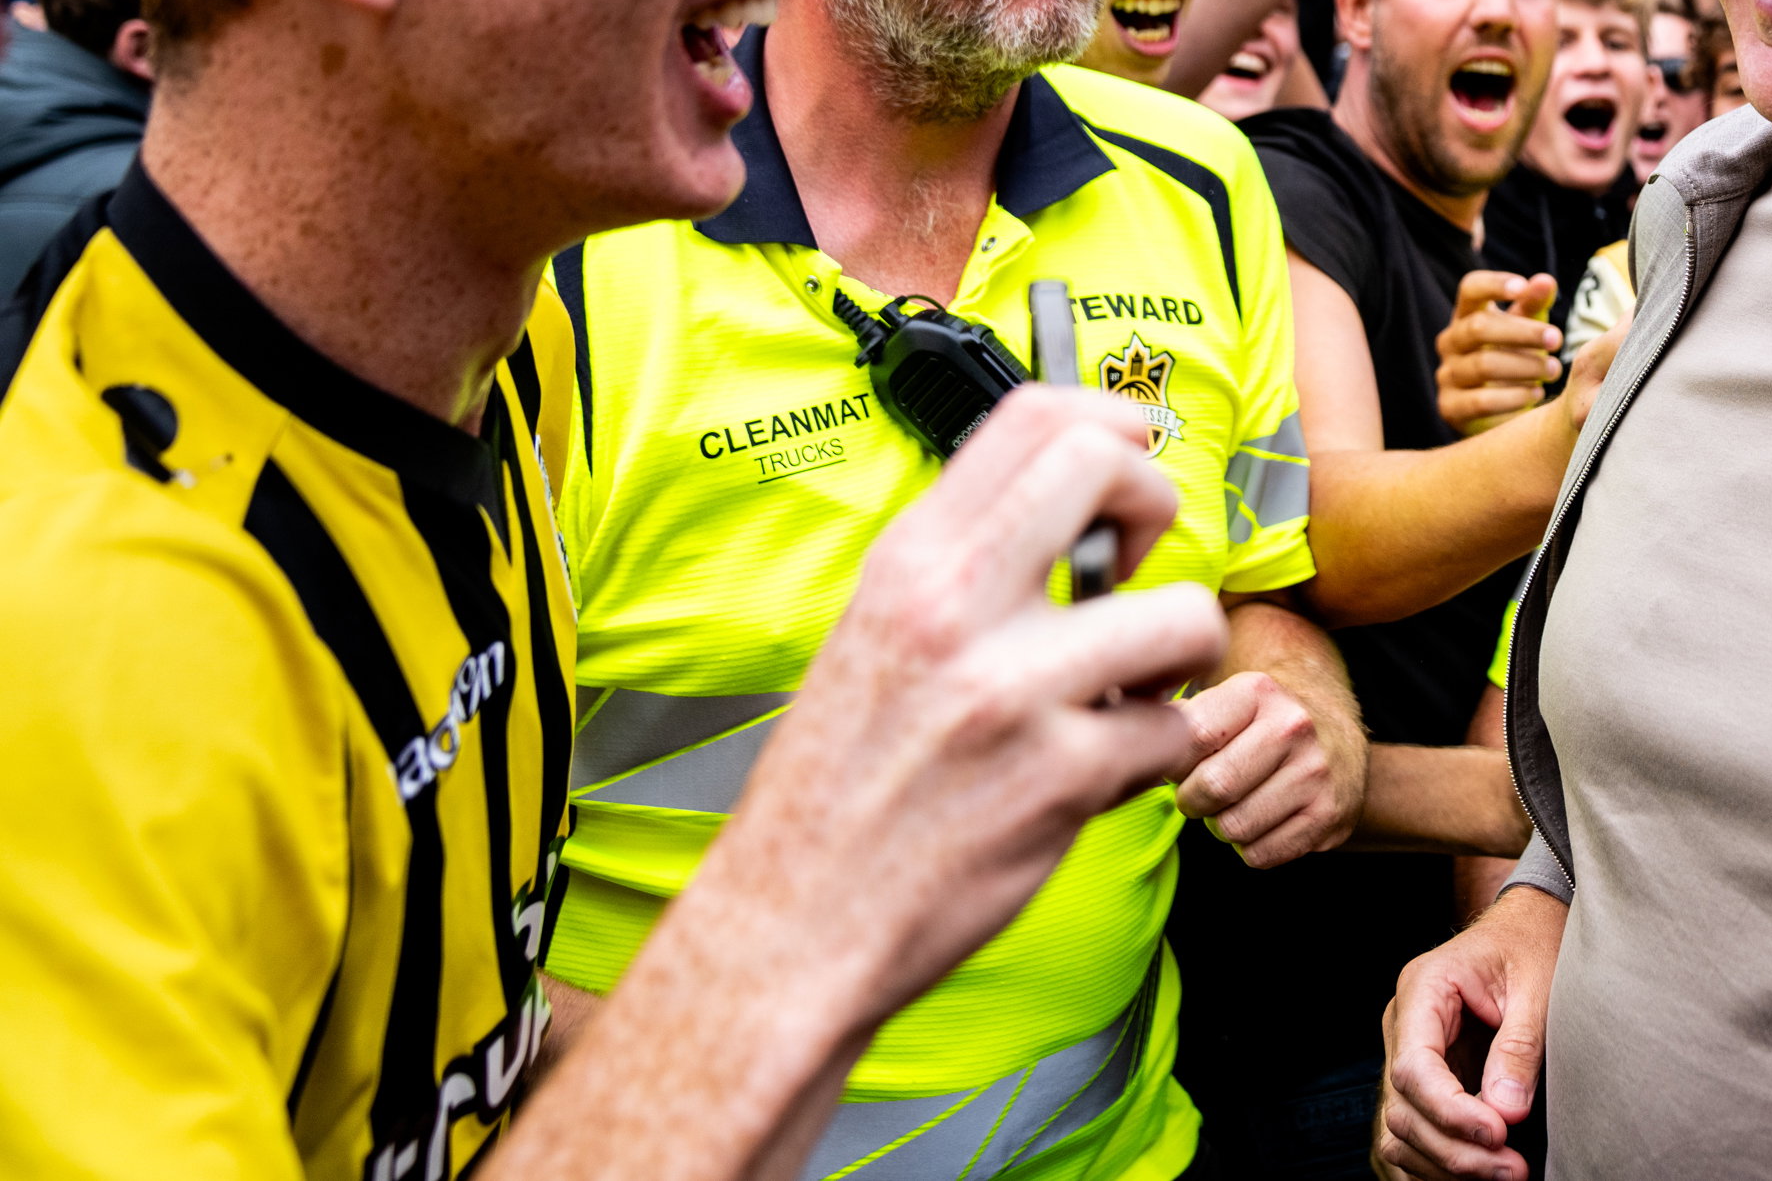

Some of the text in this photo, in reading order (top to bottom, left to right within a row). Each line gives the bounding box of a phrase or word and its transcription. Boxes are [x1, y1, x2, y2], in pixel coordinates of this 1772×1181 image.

[1069, 295, 1203, 325] EWARD
[699, 392, 870, 460] CLEANMAT
[753, 437, 845, 476] TRUCKS
